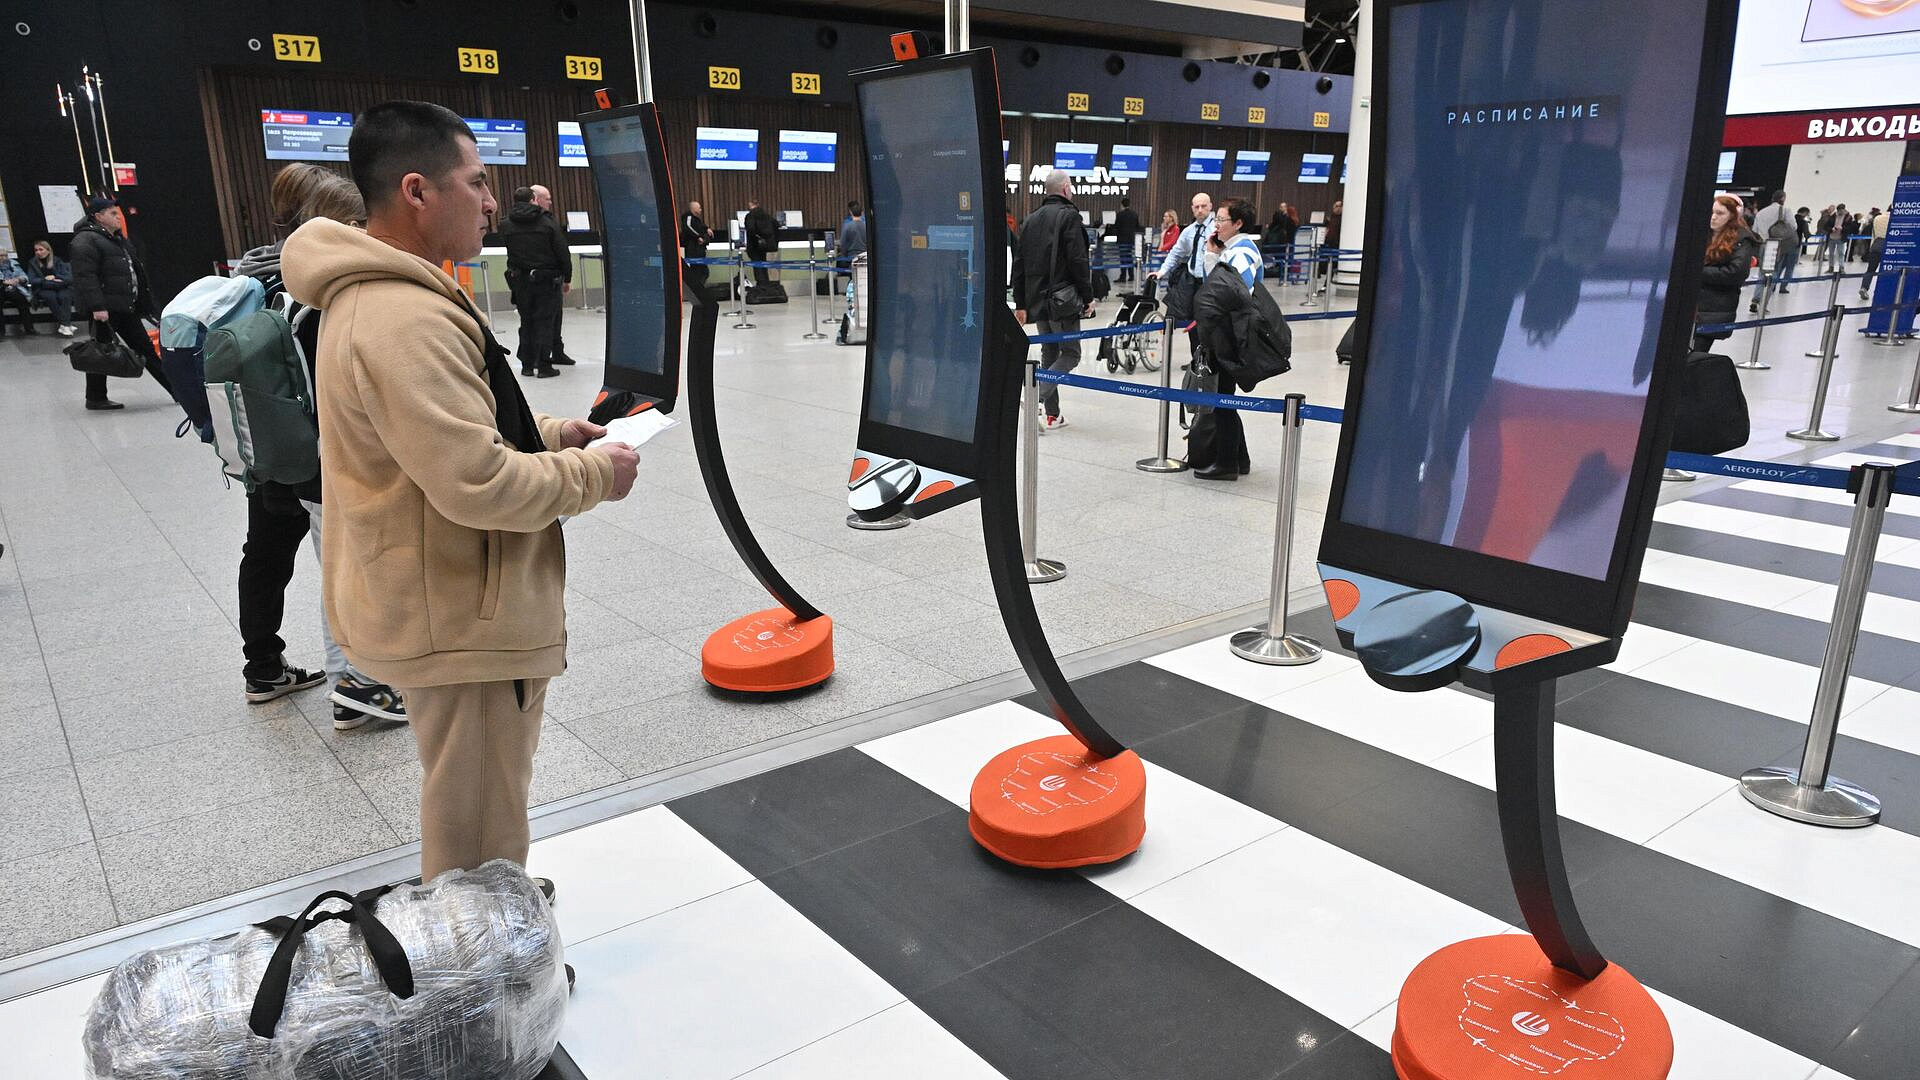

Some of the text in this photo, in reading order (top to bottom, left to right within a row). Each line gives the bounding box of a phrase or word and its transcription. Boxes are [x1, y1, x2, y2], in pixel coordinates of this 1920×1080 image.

[278, 39, 316, 57] 317
[462, 52, 496, 69] 318
[569, 60, 600, 76] 319
[712, 70, 738, 85] 320
[795, 76, 818, 90] 321
[1070, 96, 1087, 108] 324
[1125, 100, 1142, 112] 325
[1203, 106, 1218, 118] 326
[1250, 109, 1264, 121] 327
[1447, 103, 1599, 125] РАСПИСАНИЕ
[1315, 114, 1328, 125] 328
[1119, 385, 1149, 395] AEROFLOT
[1219, 398, 1254, 407] AEROFLOT
[1722, 464, 1786, 477] AEROFLOT
